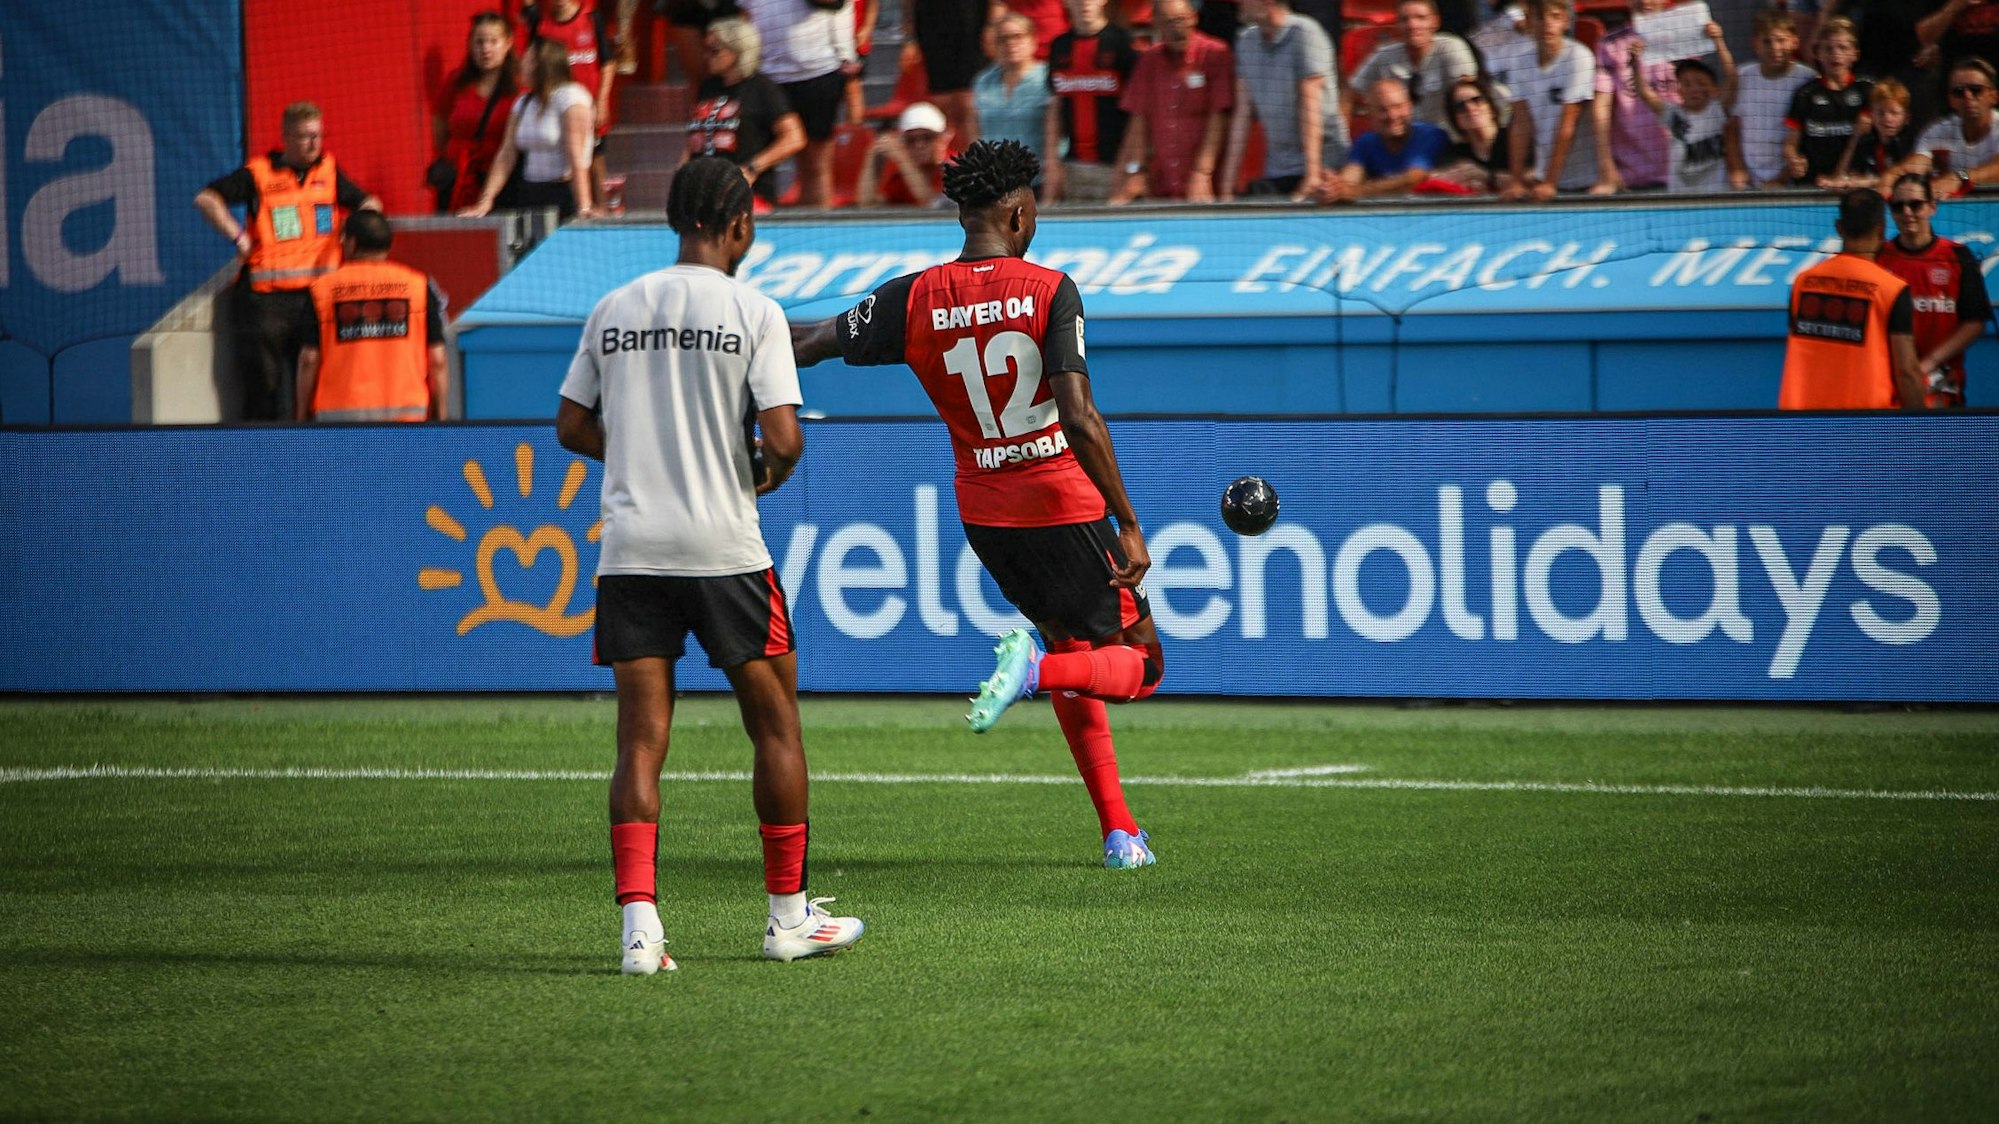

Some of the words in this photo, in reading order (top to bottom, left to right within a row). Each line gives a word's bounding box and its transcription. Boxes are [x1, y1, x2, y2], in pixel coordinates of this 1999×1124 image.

[0, 60, 166, 294] a
[1231, 240, 1618, 294] EINFACH.
[931, 299, 1004, 331] BAYER
[1005, 295, 1035, 319] 04
[602, 325, 741, 356] Barmenia
[942, 329, 1060, 440] 12
[972, 429, 1069, 470] TAPSOBA
